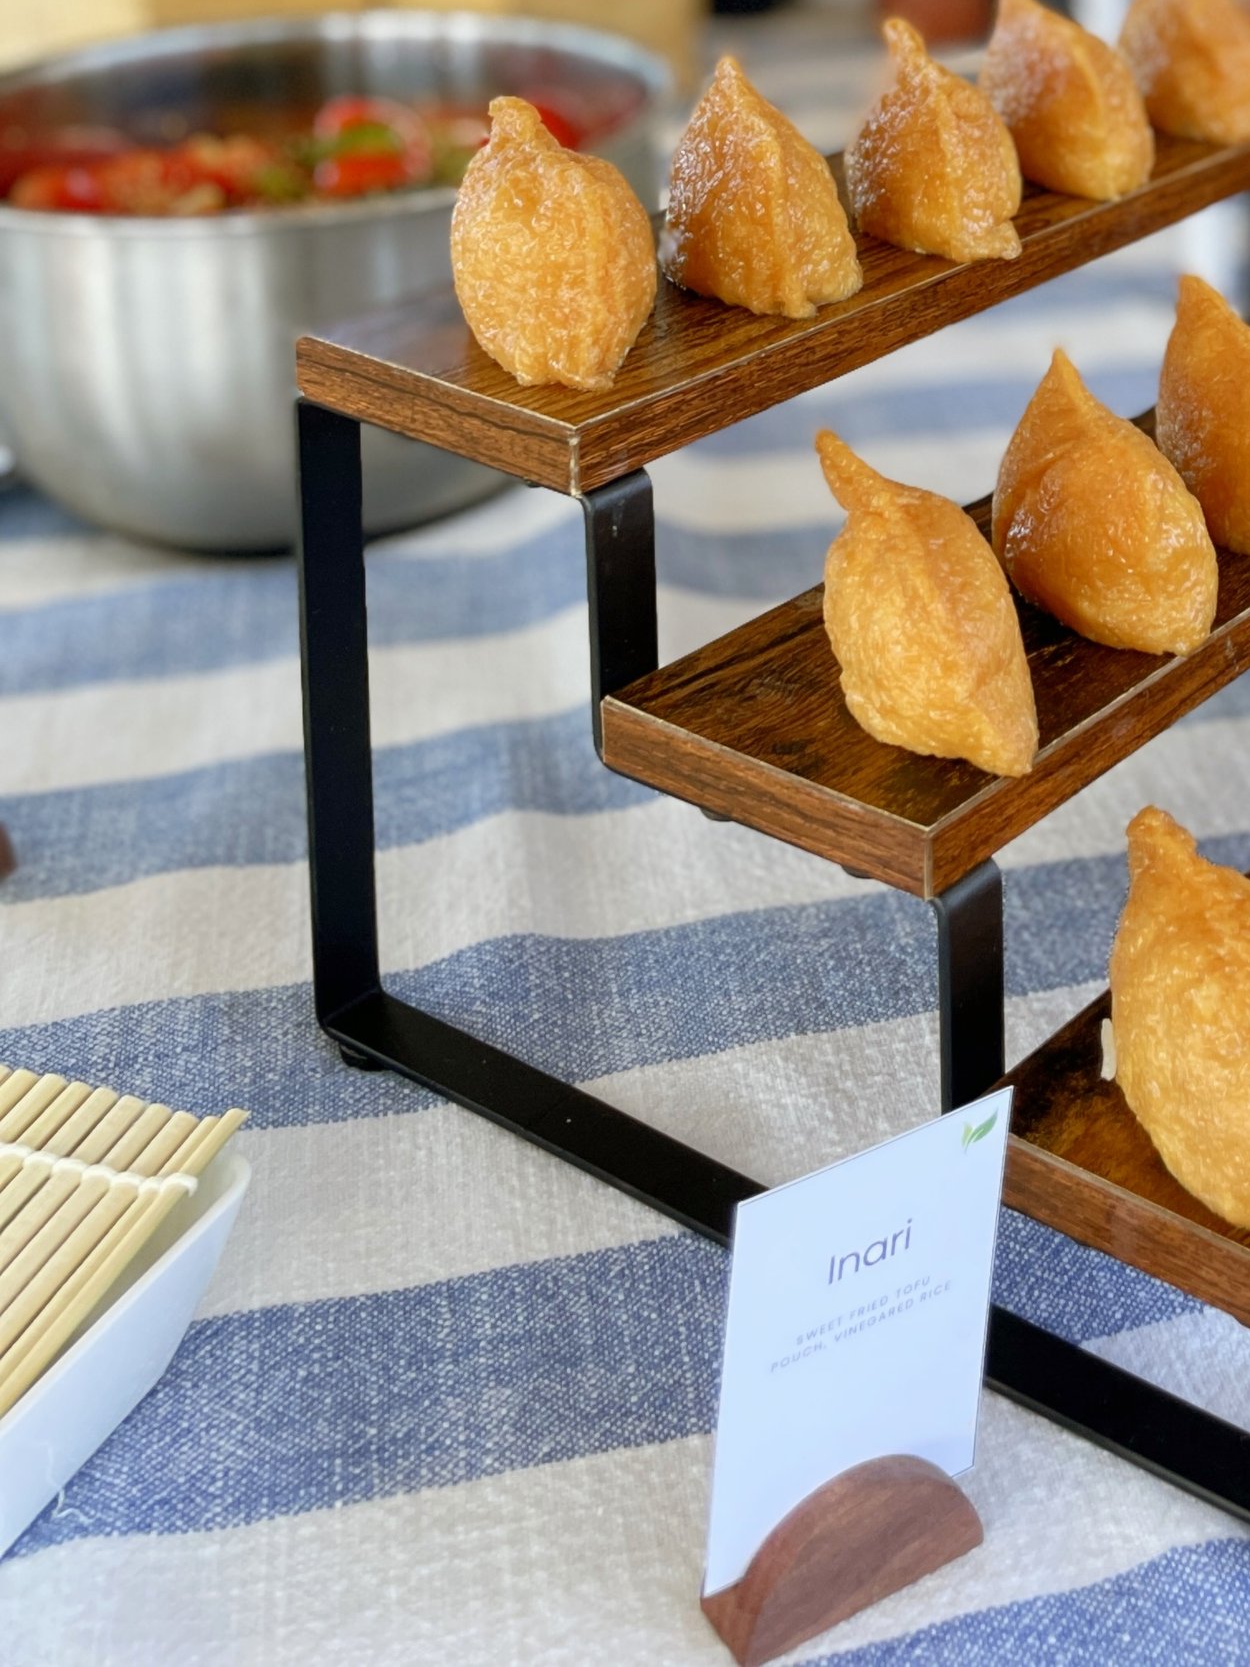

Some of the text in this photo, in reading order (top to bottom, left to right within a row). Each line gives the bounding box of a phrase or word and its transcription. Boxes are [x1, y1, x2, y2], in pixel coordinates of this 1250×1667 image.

[828, 1218, 913, 1285] Inari
[796, 1276, 930, 1345] SWEET FRIED TOFU
[834, 1298, 914, 1342] VINEGARED
[920, 1280, 951, 1302] RICE
